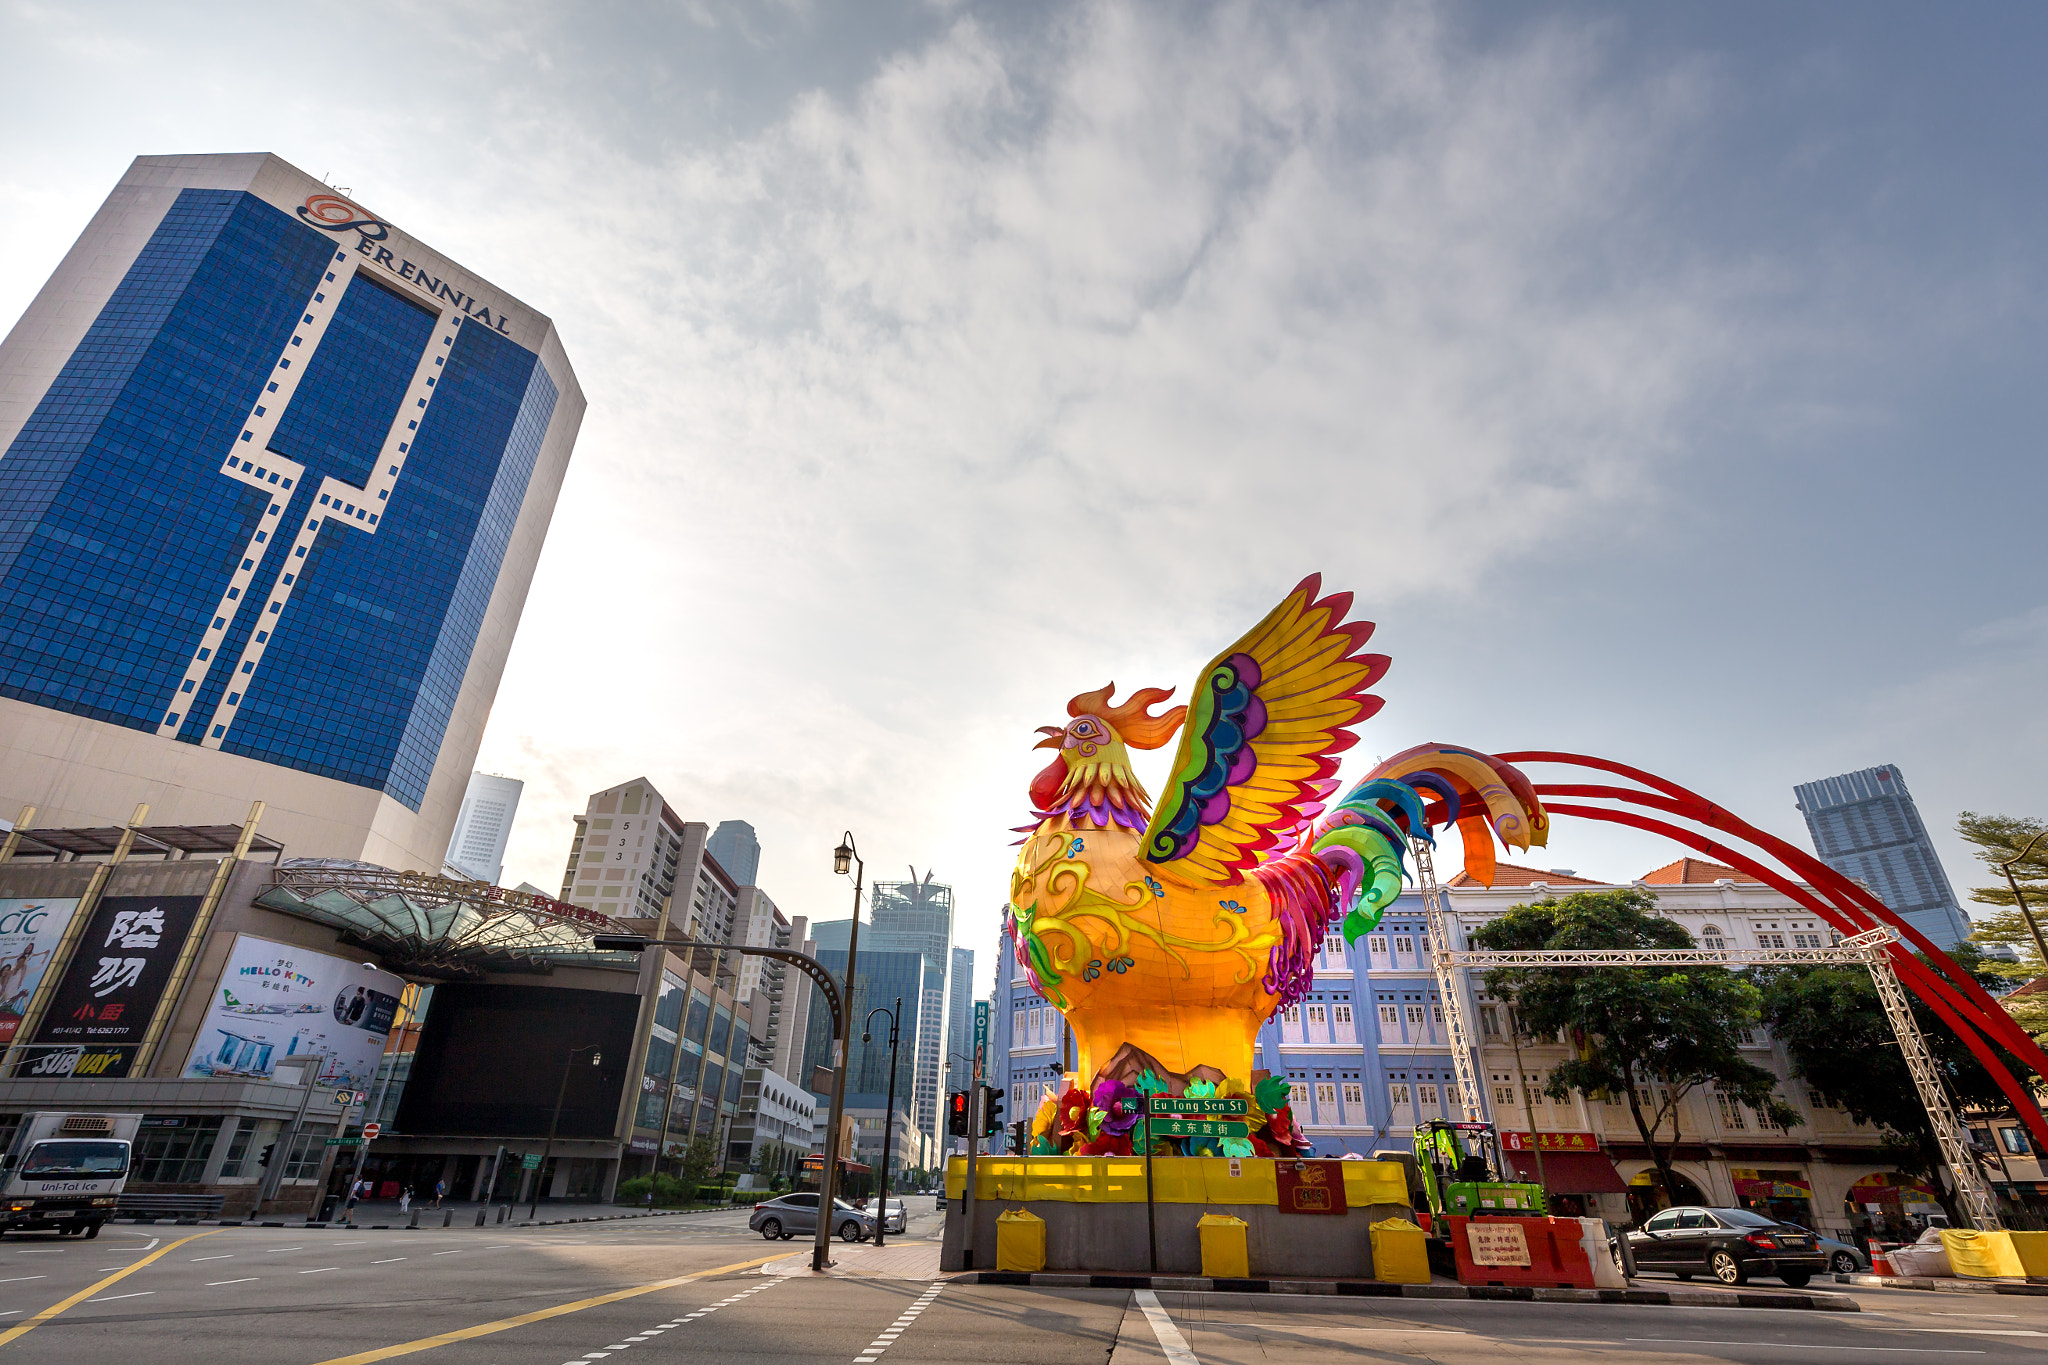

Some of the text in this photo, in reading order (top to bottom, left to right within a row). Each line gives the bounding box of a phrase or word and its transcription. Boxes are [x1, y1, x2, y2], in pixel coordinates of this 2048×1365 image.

[296, 195, 511, 335] PERENNIAL
[240, 966, 315, 987] HELLO KITTY
[32, 1053, 122, 1074] SUBWAY
[1154, 1100, 1242, 1112] Eu Tong Sen St
[82, 1182, 98, 1190] Ice
[1743, 1185, 1769, 1195] SALE
